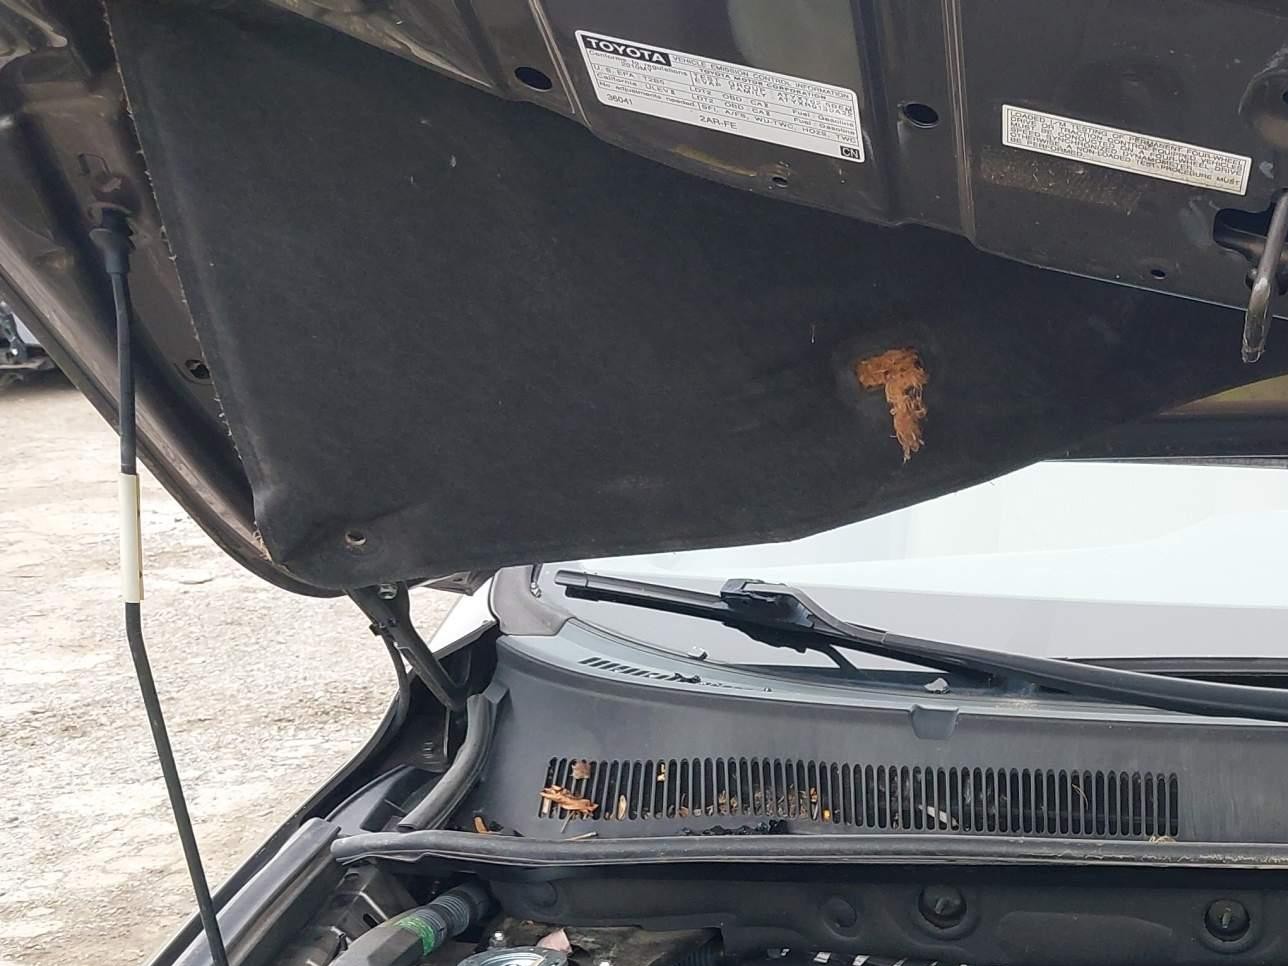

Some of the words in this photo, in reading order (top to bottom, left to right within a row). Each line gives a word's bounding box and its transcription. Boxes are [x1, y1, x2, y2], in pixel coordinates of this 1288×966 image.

[587, 38, 665, 63] TOYOTA
[589, 50, 627, 62] Conforms
[644, 63, 687, 75] regulations
[673, 56, 705, 66] VEHICLE
[711, 64, 748, 76] EMISSION
[753, 74, 789, 85] CONTROL
[796, 83, 848, 98] INFORMATION
[700, 69, 729, 78] TOYOTA
[734, 76, 762, 85] MOTOR
[767, 83, 826, 99] CORPORATION
[728, 81, 765, 92] GROUP
[596, 73, 637, 85] California
[819, 123, 854, 133] Gasoline
[615, 85, 661, 99] adjustments
[730, 86, 767, 97] FAMILY
[699, 115, 737, 129] 2AR-FE
[818, 115, 853, 126] Gasoline
[1011, 111, 1045, 122] LOADED
[1072, 124, 1107, 135] TESTING
[1128, 137, 1181, 151] PERMANENT
[842, 147, 858, 158] CN
[1010, 127, 1040, 137] SPEED
[1049, 135, 1117, 153] SYNCHRONIZED
[1010, 117, 1036, 126] DRIVE
[1060, 127, 1102, 140] TRACTION
[1200, 157, 1242, 169] VEHICLES
[1010, 122, 1034, 131] MUST
[1058, 132, 1114, 148] CONDUCTED
[1214, 165, 1241, 174] DRIVE
[1216, 176, 1239, 184] MUST
